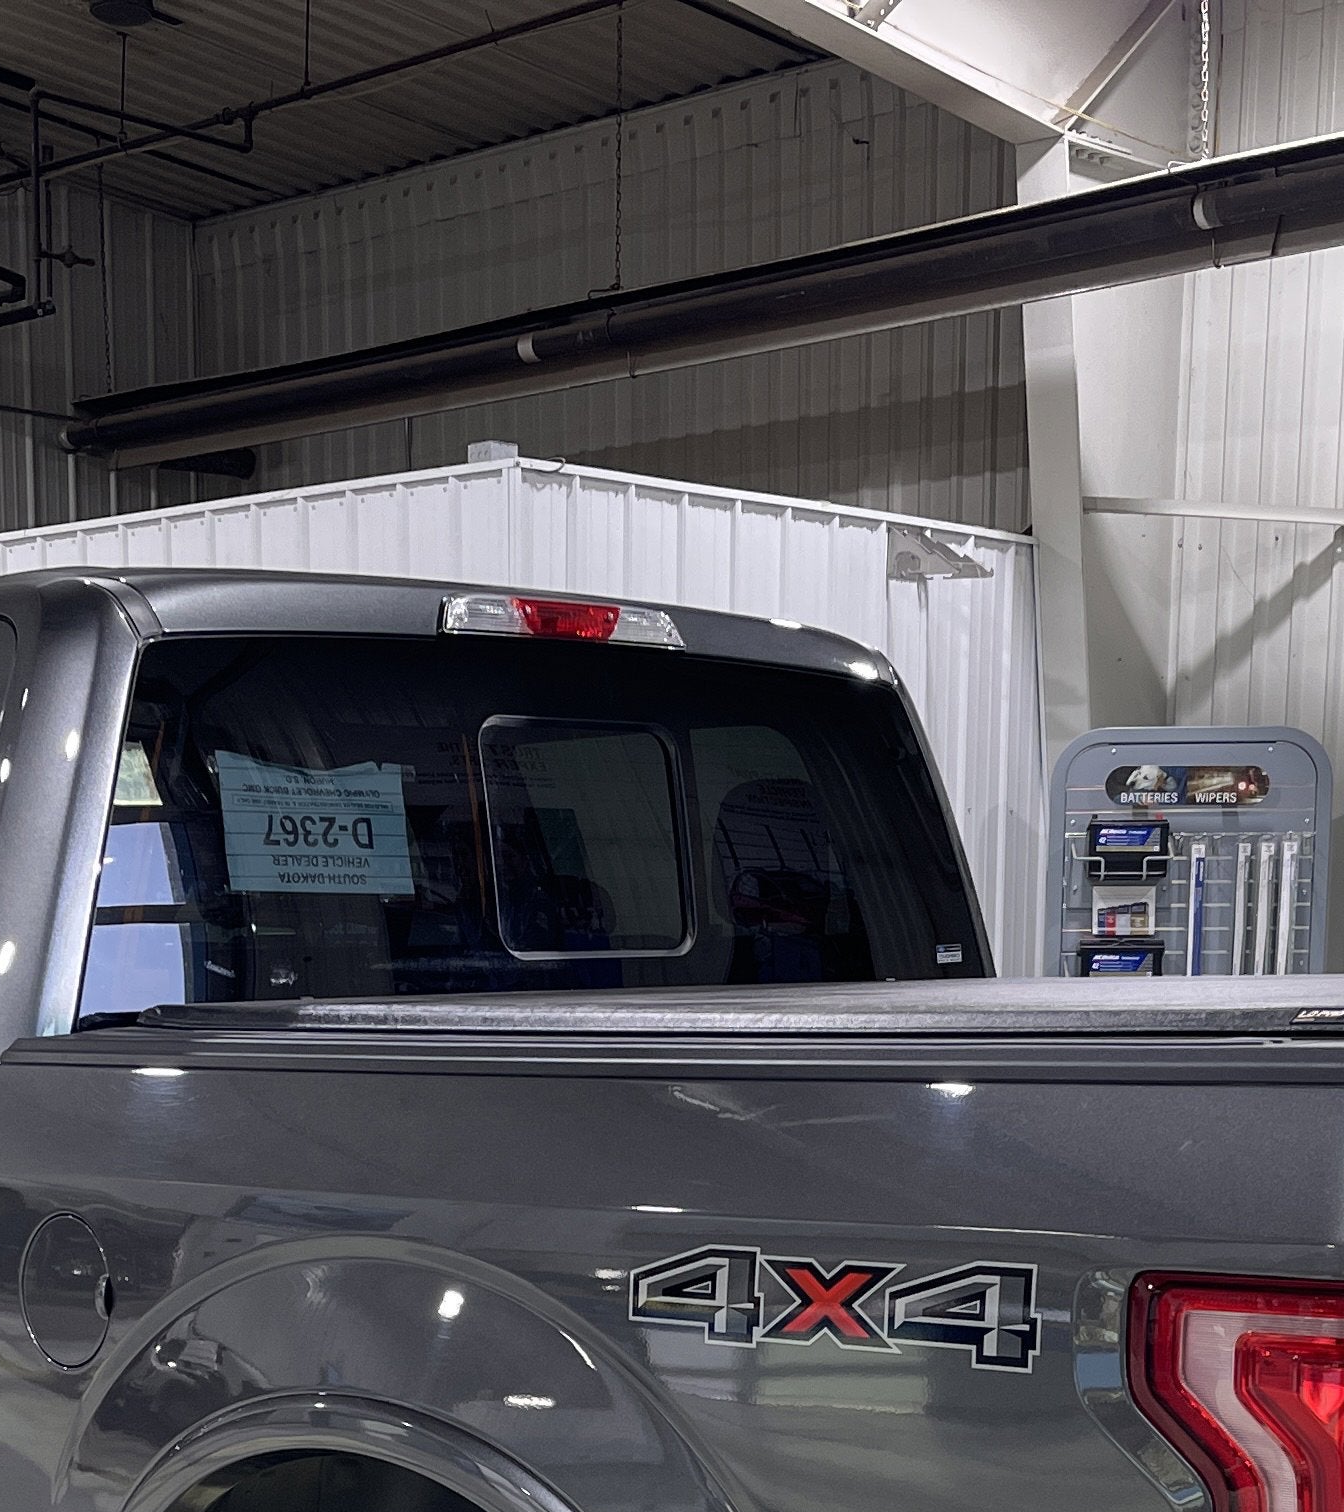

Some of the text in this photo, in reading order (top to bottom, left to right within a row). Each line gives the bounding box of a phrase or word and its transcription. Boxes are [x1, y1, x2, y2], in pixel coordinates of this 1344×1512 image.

[263, 785, 289, 797] BUICK
[290, 785, 342, 799] CHEVROLET
[1120, 791, 1238, 804] BATTERIES WIPERS
[263, 813, 375, 850] D-2367
[272, 854, 370, 868] VEHICLE DEALER
[277, 871, 367, 885] SOUTH DAKOTA
